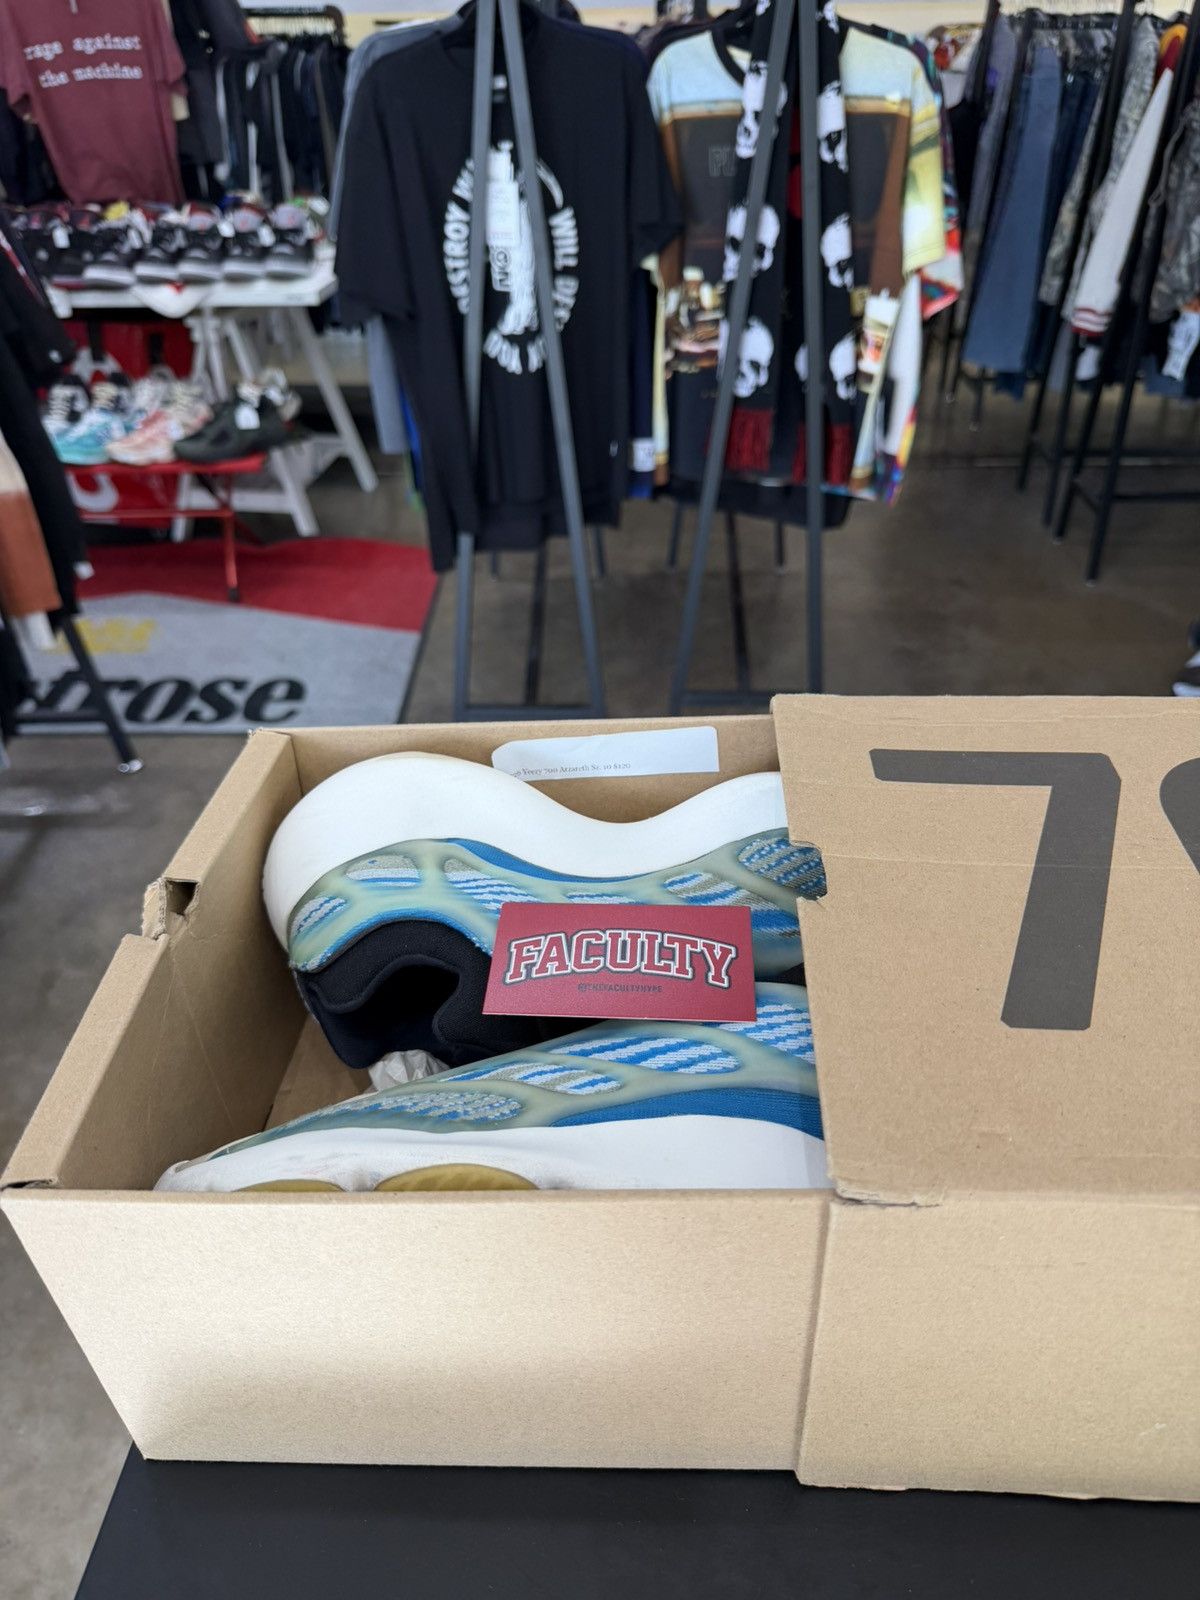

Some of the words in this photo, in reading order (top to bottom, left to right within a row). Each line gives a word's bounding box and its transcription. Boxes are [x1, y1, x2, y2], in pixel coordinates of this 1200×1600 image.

[24, 41, 62, 60] rage
[72, 33, 141, 54] against
[39, 71, 69, 88] the
[72, 63, 142, 81] machine
[868, 748, 1200, 1031] 7
[504, 928, 738, 988] FACULTY
